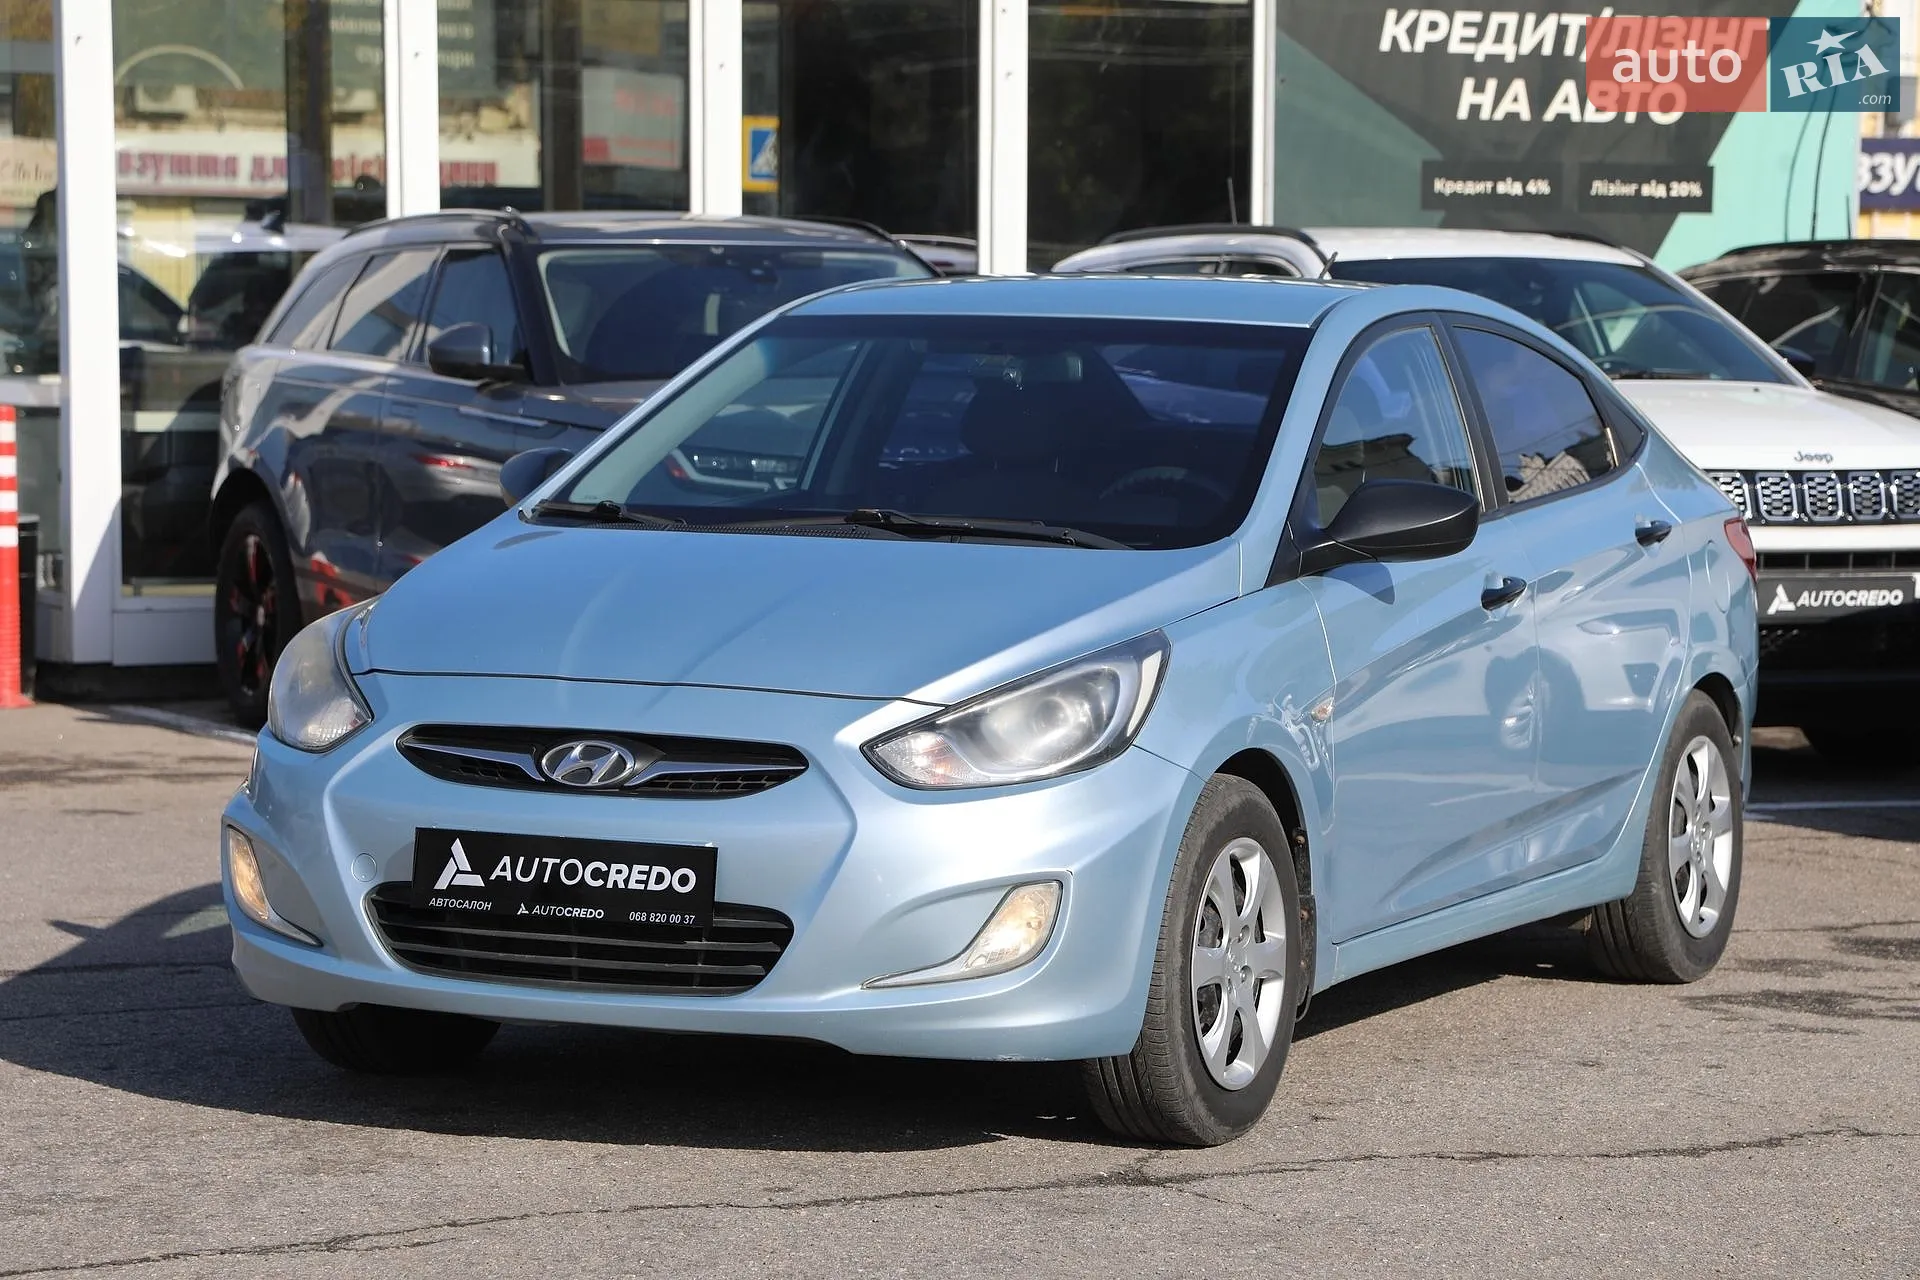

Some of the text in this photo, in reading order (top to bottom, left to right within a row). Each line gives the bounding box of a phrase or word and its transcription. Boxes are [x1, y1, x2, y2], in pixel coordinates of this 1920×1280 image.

[1456, 77, 1688, 126] НА АВТО
[1433, 177, 1551, 197] Кредит від 4%
[1641, 179, 1667, 198] від
[1669, 181, 1702, 198] 20%
[1794, 451, 1833, 463] Jeep
[1796, 590, 1904, 607] AUTOCREDO
[489, 855, 697, 893] AUTOCREDO
[428, 897, 492, 911] АВТОСАЛОН
[531, 905, 605, 919] AUTOCREDO
[628, 911, 695, 924] 068 820 00 37
